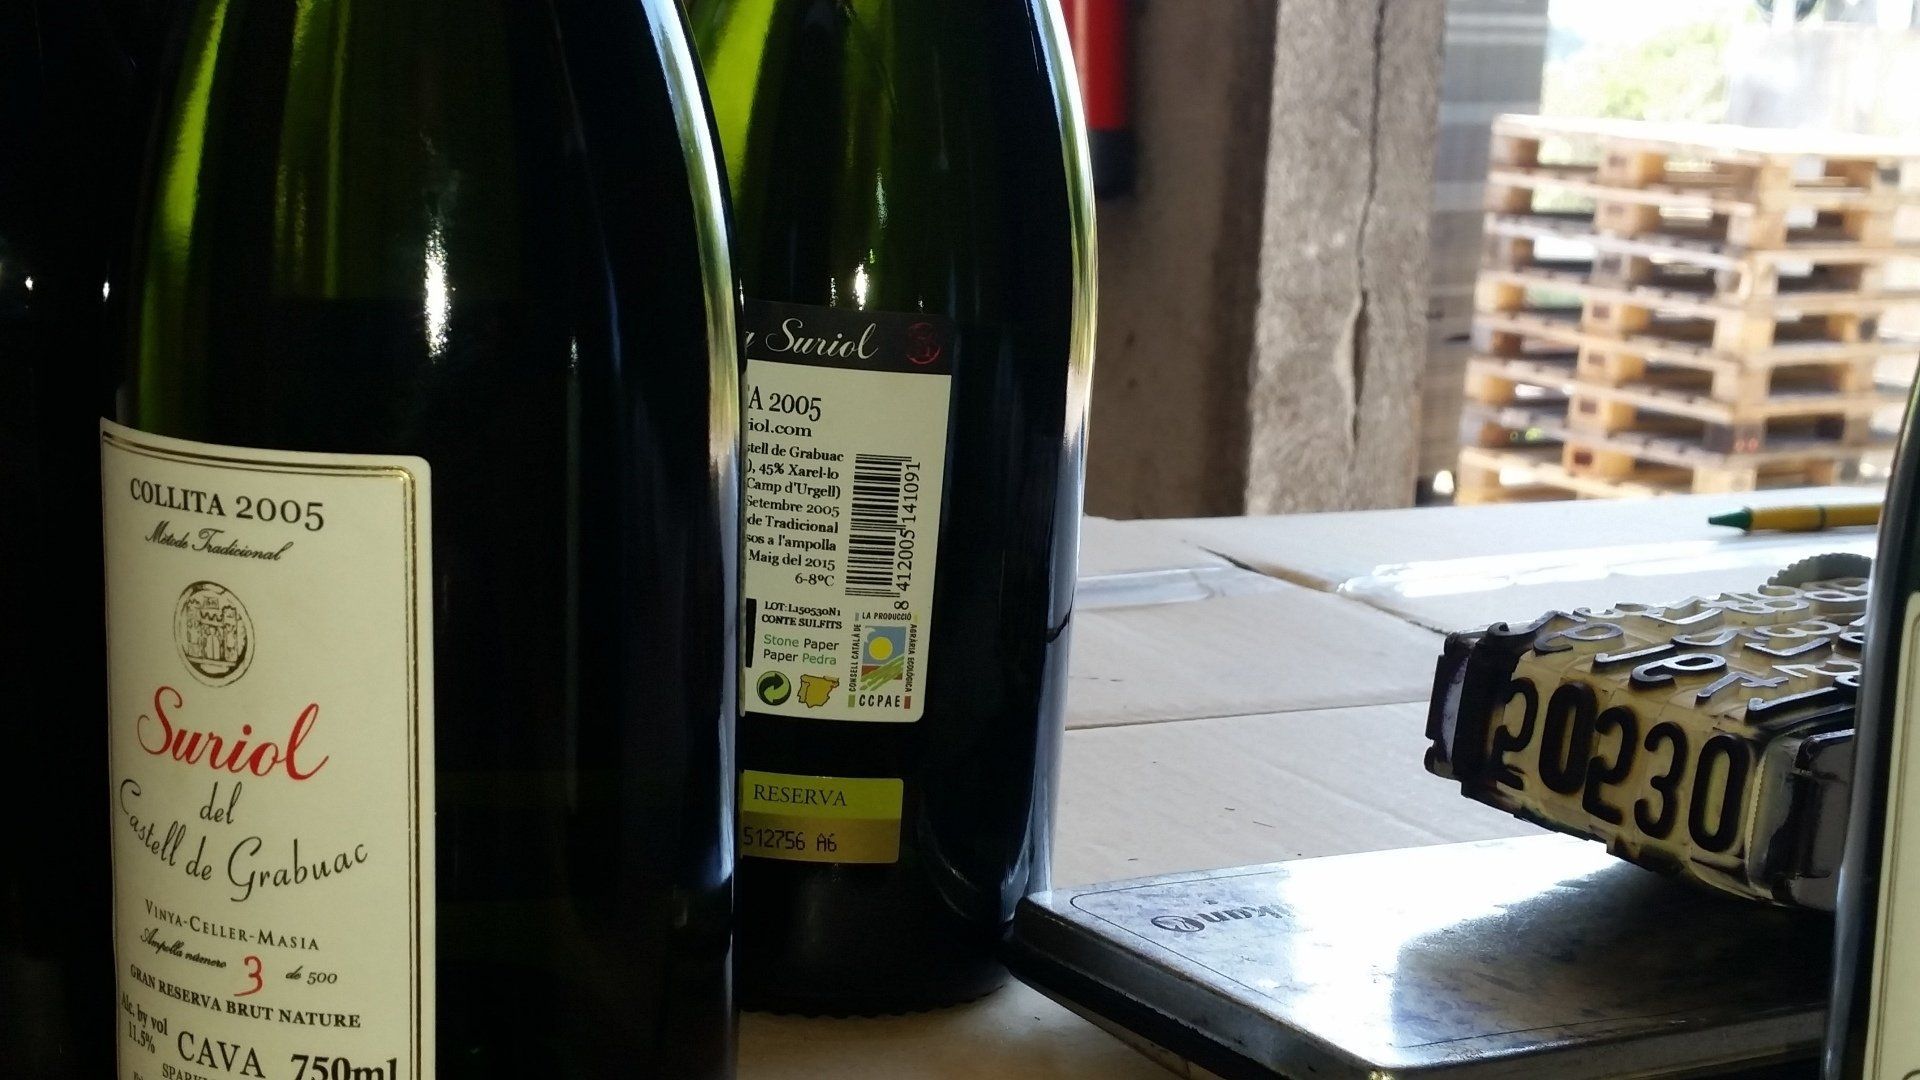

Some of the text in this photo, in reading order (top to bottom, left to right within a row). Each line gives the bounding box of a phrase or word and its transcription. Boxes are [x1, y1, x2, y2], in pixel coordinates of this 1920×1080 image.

[766, 318, 879, 360] Suriol
[747, 385, 822, 422] A 2005
[748, 417, 812, 438] iol.com
[771, 443, 787, 457] de
[789, 446, 844, 462] Grabuac
[758, 462, 785, 476] 45%
[784, 480, 841, 499] d'Urgell)
[901, 461, 921, 524] 141091
[130, 477, 325, 532] COLLITA 2005
[746, 494, 840, 518] Setembre 2005
[765, 515, 839, 534] Tradicional
[191, 527, 294, 561] Tradicional
[767, 537, 775, 546] a
[778, 534, 837, 552] l'ampolla
[748, 549, 836, 572] Maig del 2015
[896, 529, 916, 592] 412005
[761, 613, 843, 630] CONTE SULFITS
[853, 623, 862, 632] DE
[861, 611, 872, 620] LA
[763, 633, 840, 653] Stone Paper
[763, 648, 837, 666] Paper Pedra
[848, 661, 860, 693] CONSELL
[858, 693, 901, 708] CCPAE
[136, 685, 330, 782] Suriol
[199, 781, 243, 825] del
[753, 783, 848, 807] RESERVA
[119, 778, 369, 902] Castell de Grabuac
[743, 826, 837, 853] 512756 A6
[140, 927, 185, 957] Ampolla
[233, 955, 264, 997] 3
[285, 965, 338, 986] de 500
[130, 963, 362, 1029] GRAN RESERVA BRUT NATURE
[137, 1003, 149, 1029] by
[150, 1017, 169, 1037] vol
[128, 1021, 157, 1056] 11.5%
[177, 1030, 266, 1079] CAVA
[290, 1053, 398, 1080] 750ml
